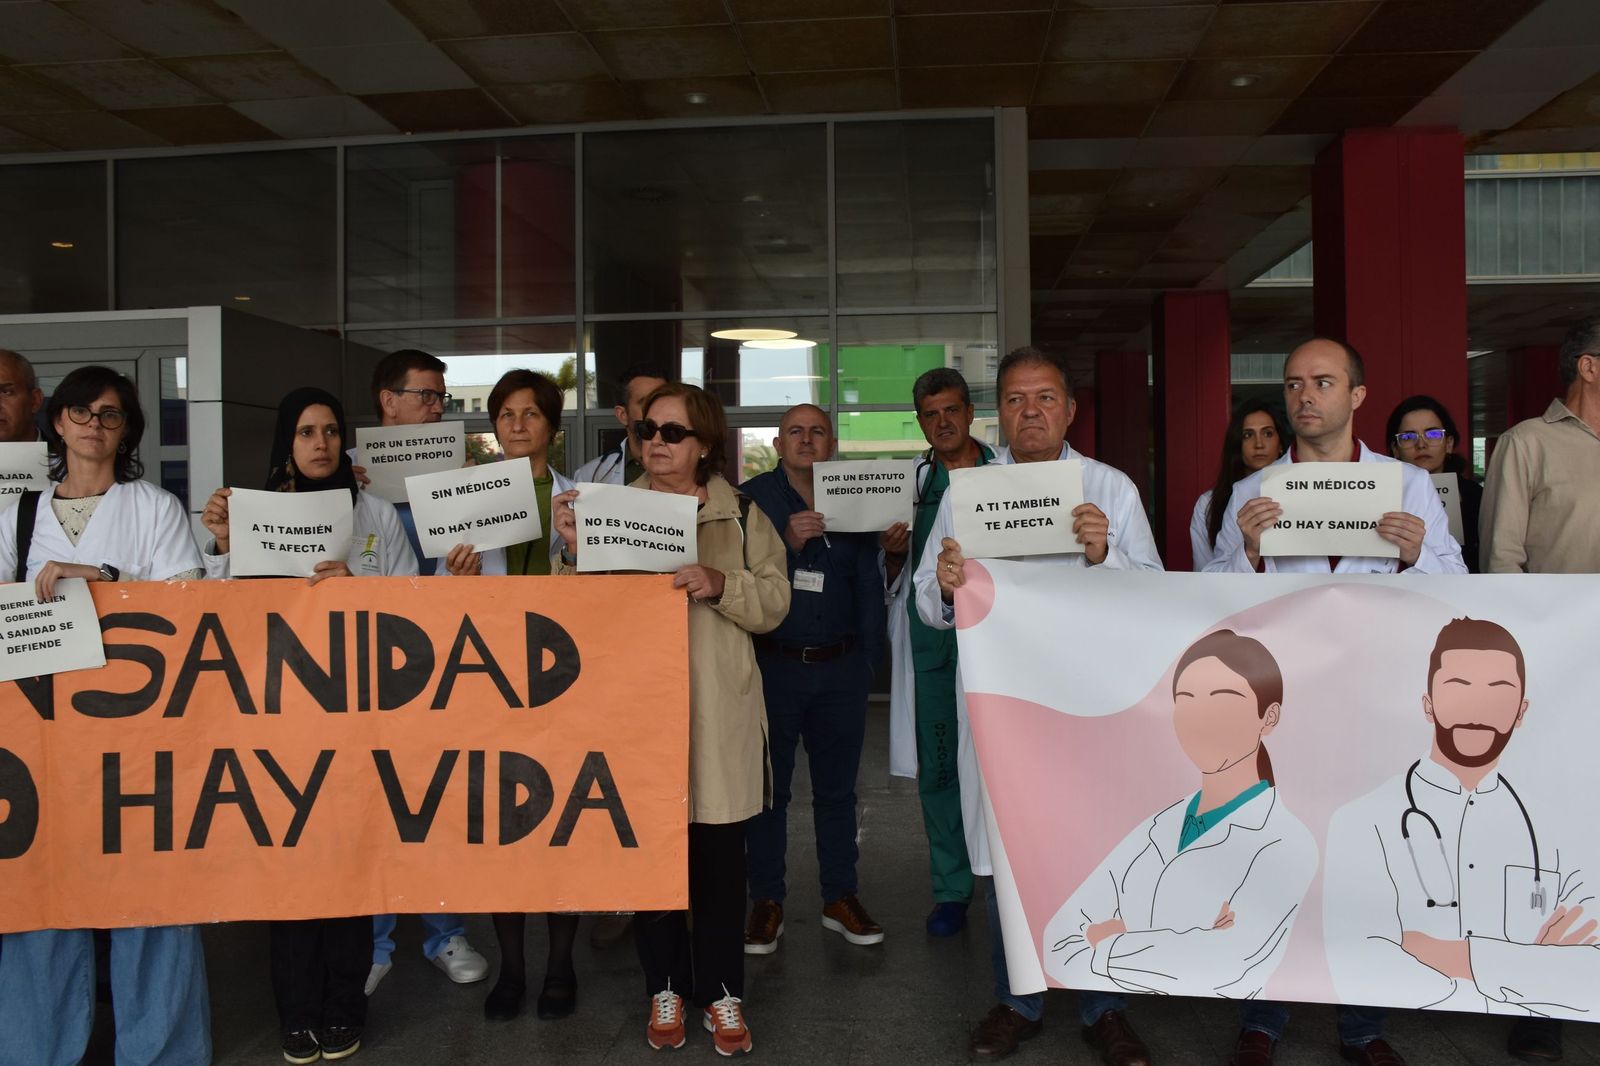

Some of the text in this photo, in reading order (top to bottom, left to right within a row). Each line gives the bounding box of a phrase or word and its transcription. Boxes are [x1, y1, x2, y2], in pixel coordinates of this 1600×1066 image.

[365, 435, 456, 450] POR UN ESTATUTO
[371, 450, 453, 465] MÉDICO PROPIO
[822, 472, 905, 483] POR UN ESTATUTO
[1285, 478, 1376, 491] SIN MÉDICOS
[431, 477, 511, 500] SIN MÉDICOS
[826, 486, 902, 496] MÉDICO PROPIO
[975, 496, 1060, 513] A TI TAMBIÉN
[252, 523, 333, 536] A TI TAMBIÉN
[428, 510, 528, 537] NO HAY SANIDAD
[584, 517, 685, 538] NO ES VOCACIÓN
[984, 517, 1054, 531] TE AFECTA
[1273, 519, 1379, 531] NO HAY SANIDA
[260, 541, 326, 553] TE AFECTA
[586, 535, 686, 554] ES EXPLOTACIÓN
[5, 609, 53, 623] GOBIERNE
[7, 624, 56, 639] SANIDAD
[59, 621, 74, 631] SE
[7, 639, 62, 655] DEFIENDE
[71, 610, 581, 718] SANIDAD
[102, 748, 336, 854] HAY
[371, 749, 639, 848] VIDA
